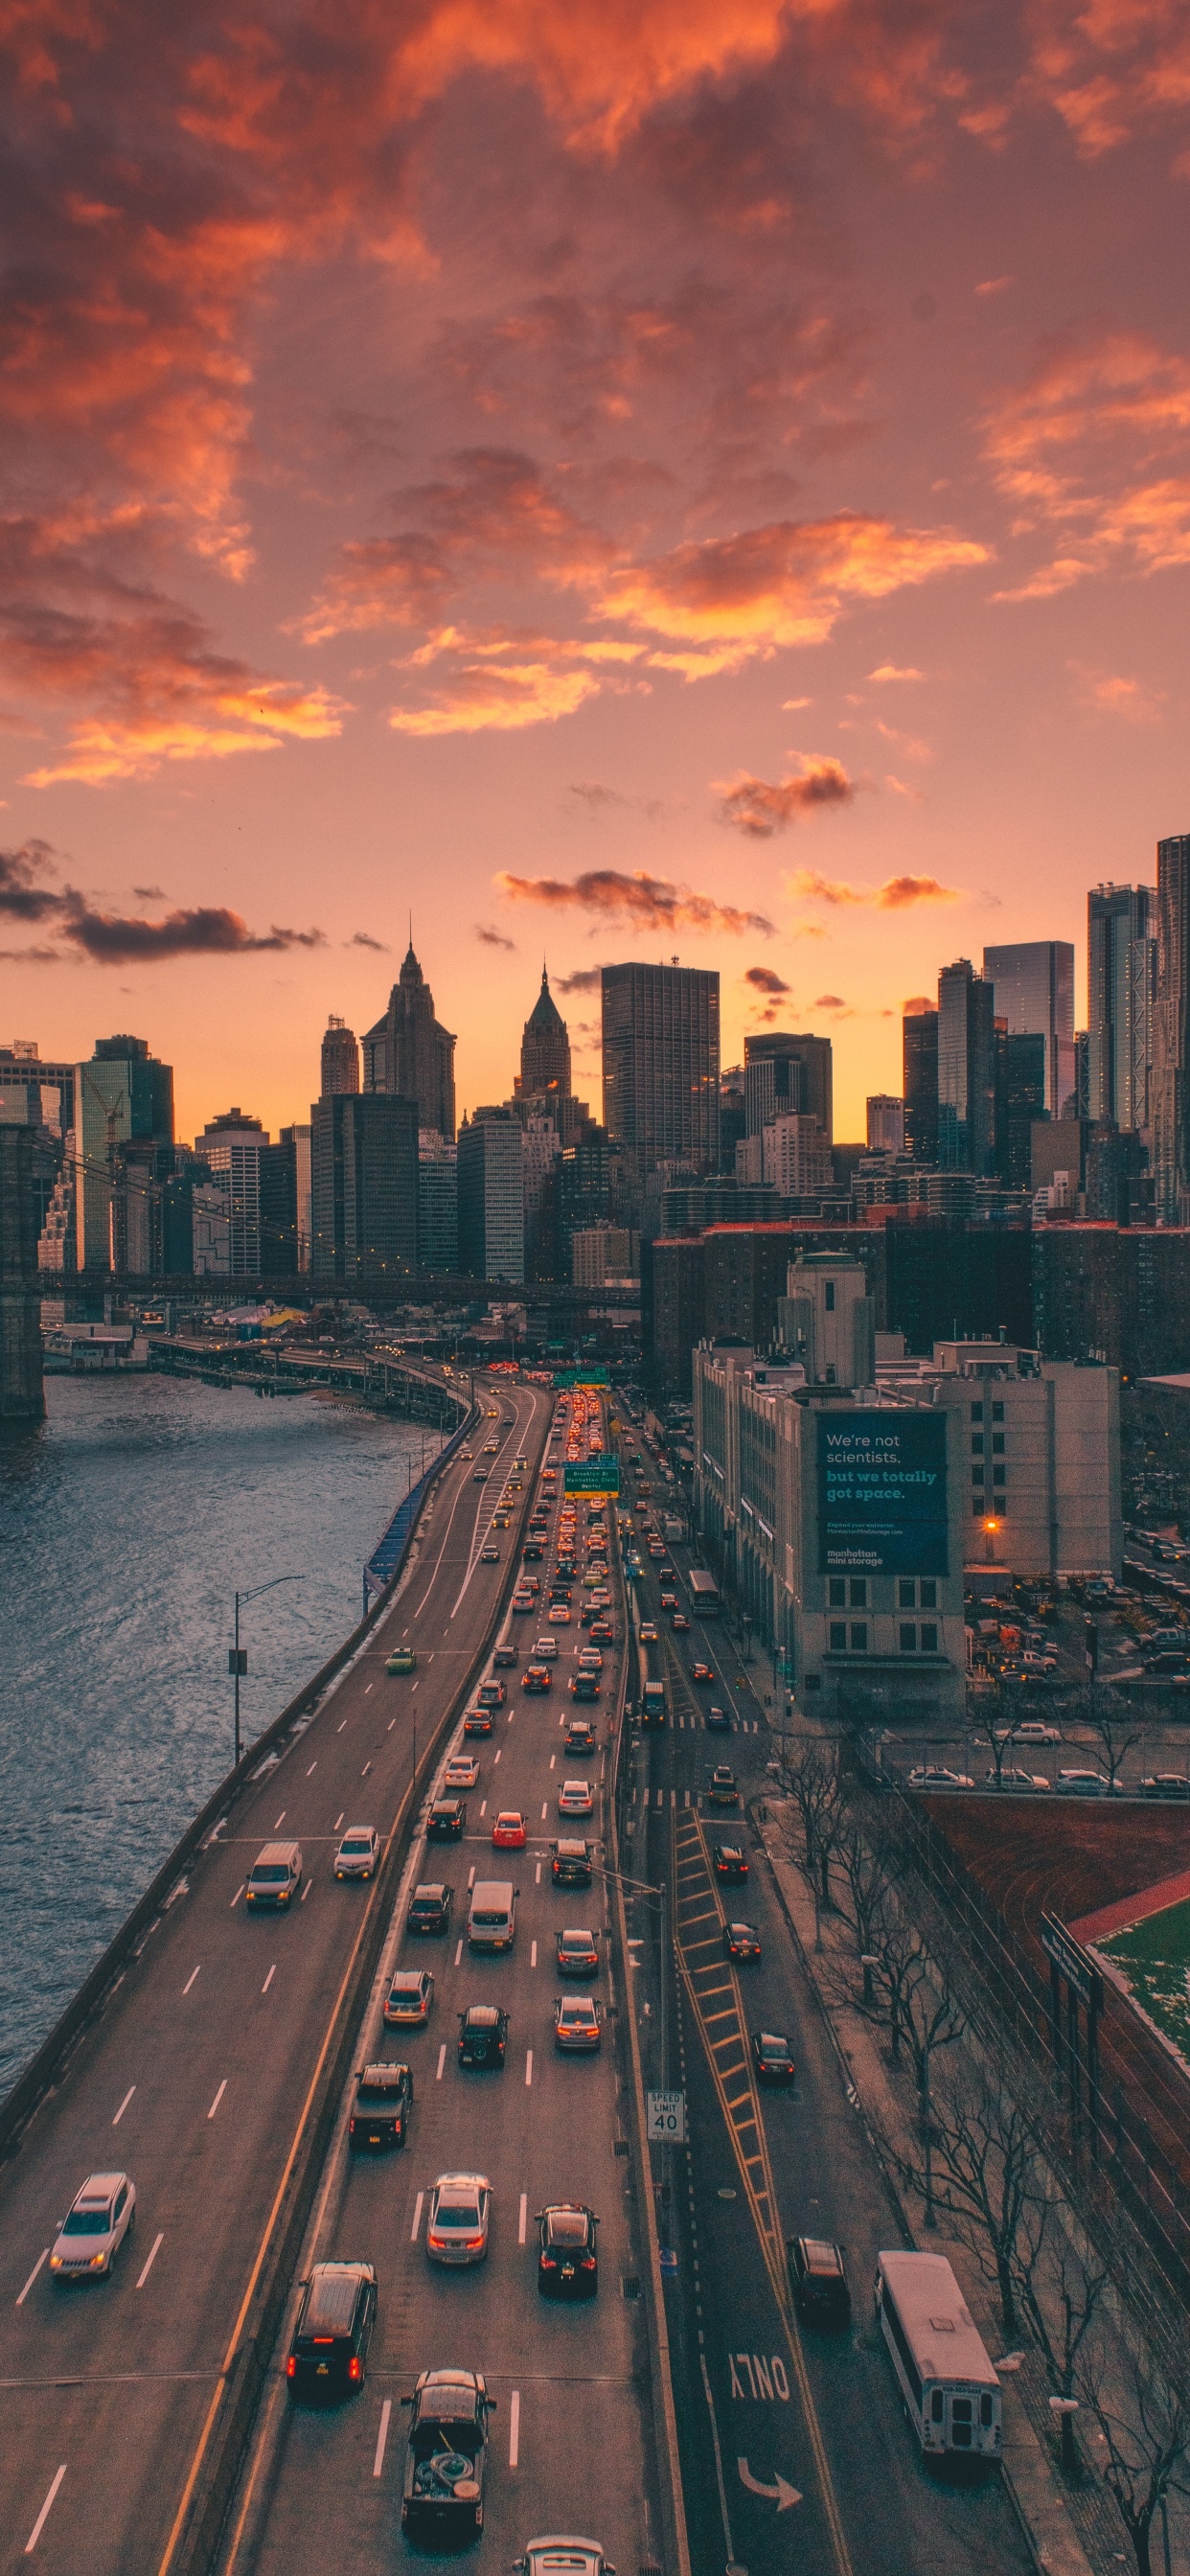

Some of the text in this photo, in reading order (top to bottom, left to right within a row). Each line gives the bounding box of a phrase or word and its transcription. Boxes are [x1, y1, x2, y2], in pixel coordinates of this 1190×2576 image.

[826, 1434, 900, 1446] We're not
[826, 1470, 937, 1485] but we totally
[827, 1488, 905, 1502] got space.
[827, 1548, 877, 1557] manhattan
[847, 1557, 882, 1567] storage
[652, 2093, 680, 2103] SPEED
[654, 2104, 675, 2112] LIMIT
[654, 2114, 677, 2129] 40
[728, 2353, 790, 2402] ONLY
